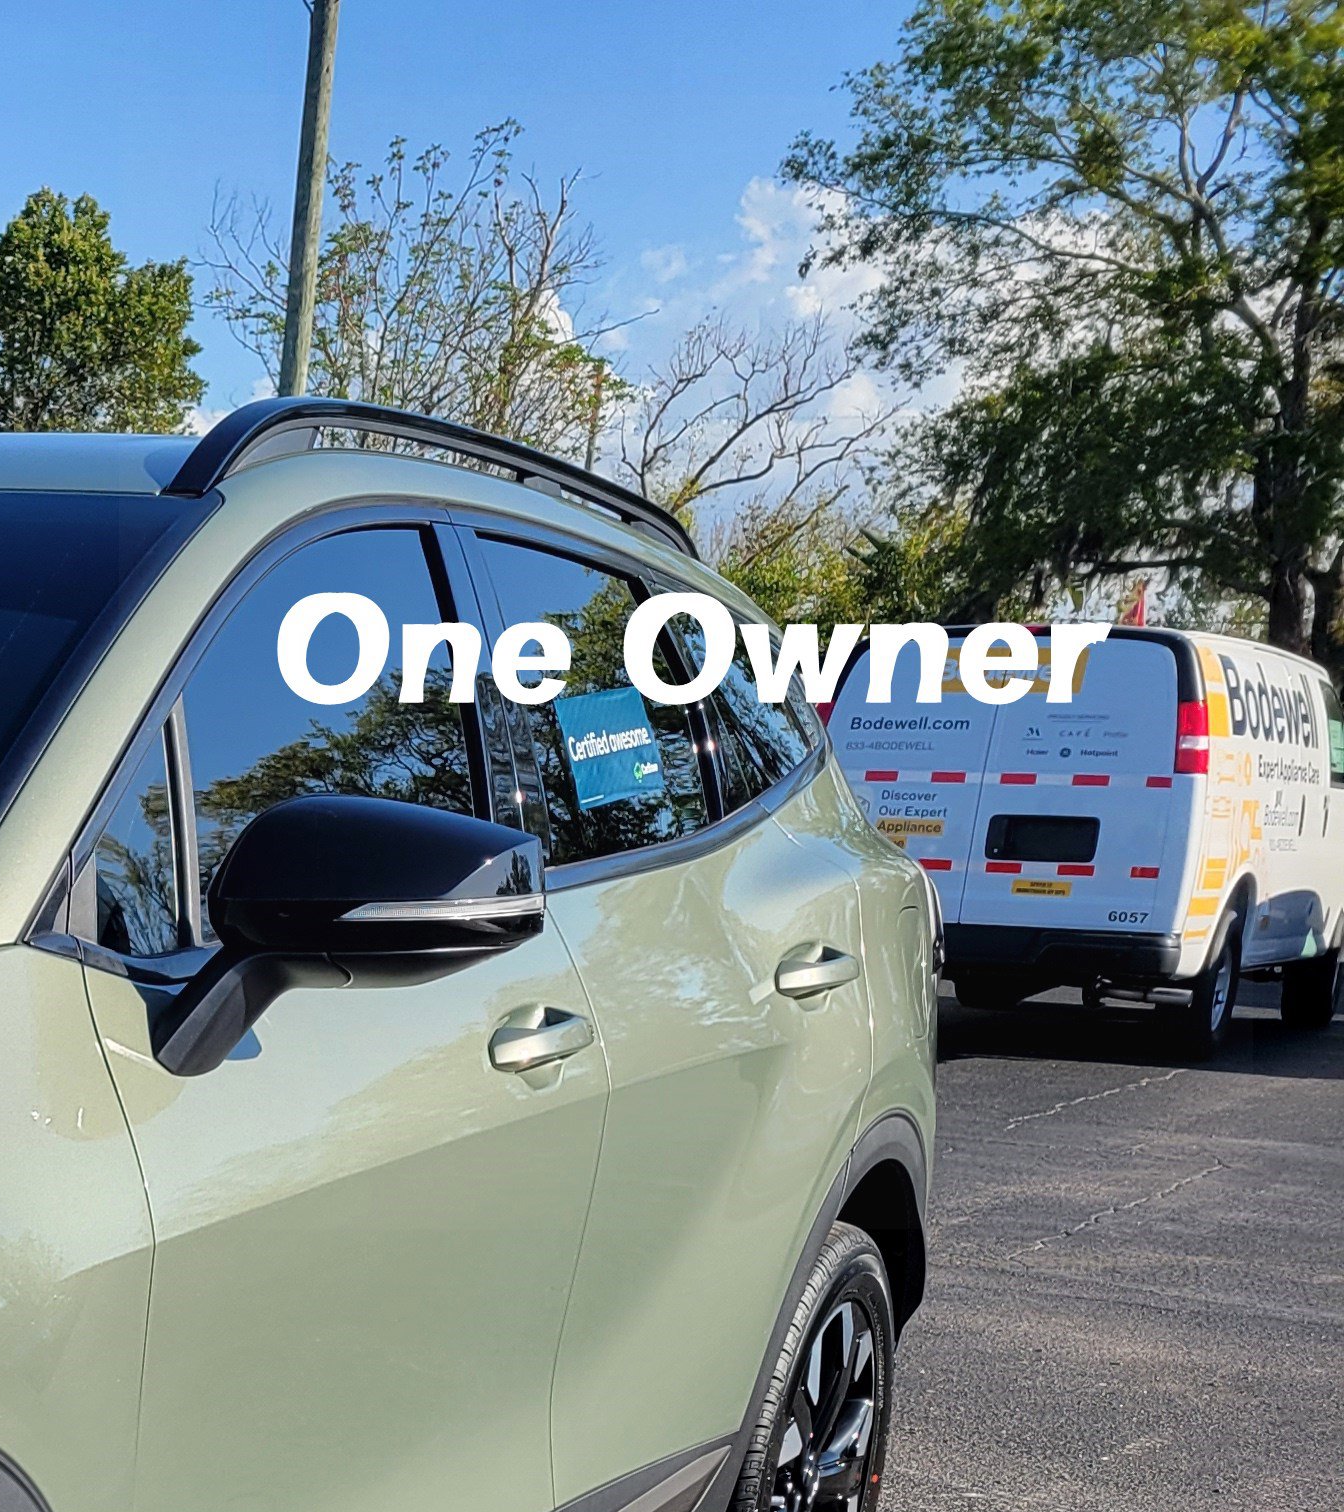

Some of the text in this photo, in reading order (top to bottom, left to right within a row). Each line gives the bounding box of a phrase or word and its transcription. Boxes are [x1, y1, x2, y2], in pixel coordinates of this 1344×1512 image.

[1218, 653, 1319, 749] Bodewell
[850, 716, 970, 731] Bodewell.com
[568, 730, 611, 762] Certified
[881, 790, 938, 801] Discover
[878, 805, 948, 819] Our Expert
[876, 820, 942, 834] Appliance
[1107, 910, 1150, 924] 6057
